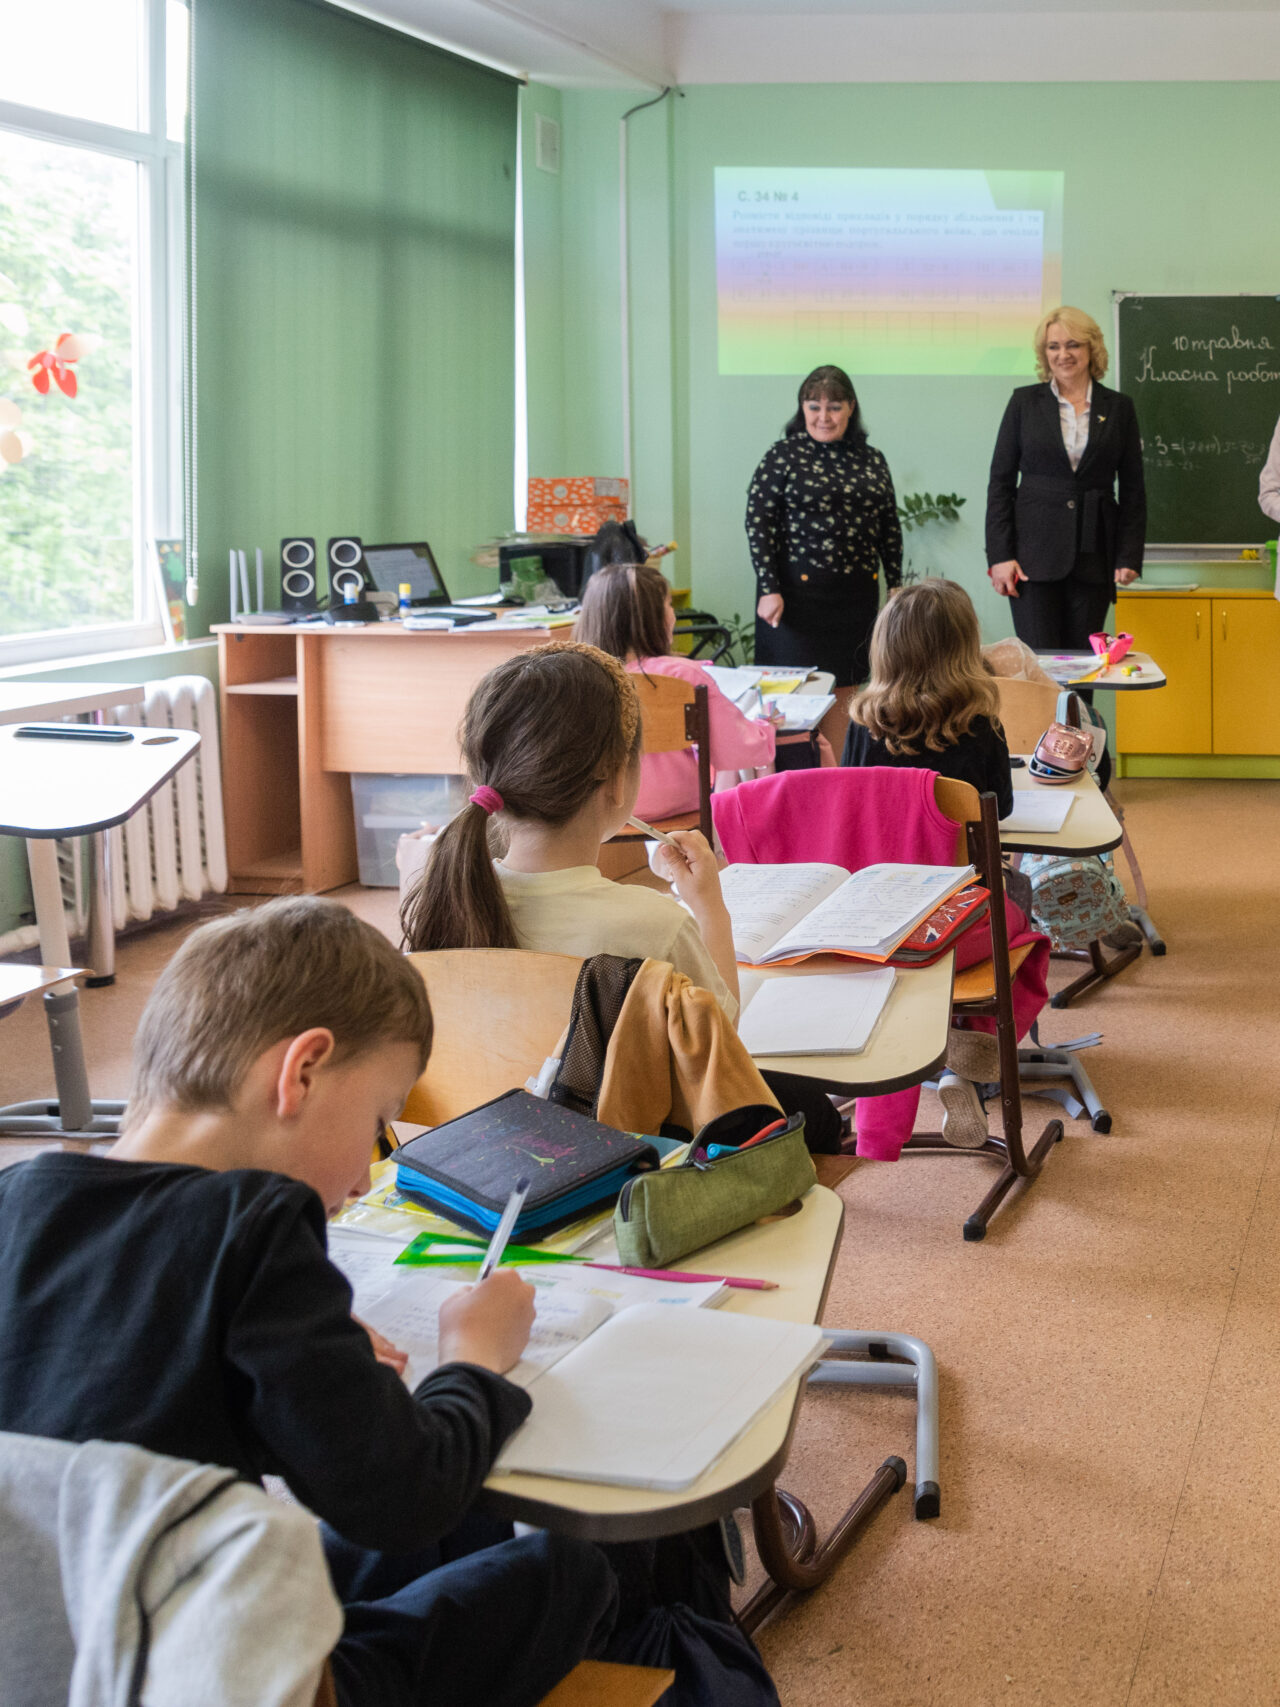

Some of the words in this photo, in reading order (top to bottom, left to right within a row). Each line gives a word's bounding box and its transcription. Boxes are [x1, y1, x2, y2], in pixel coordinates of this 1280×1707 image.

[754, 190, 769, 202] 34
[791, 190, 799, 202] 4
[1172, 335, 1189, 351] 10
[1191, 324, 1275, 360] травня
[1135, 345, 1220, 384] Класна
